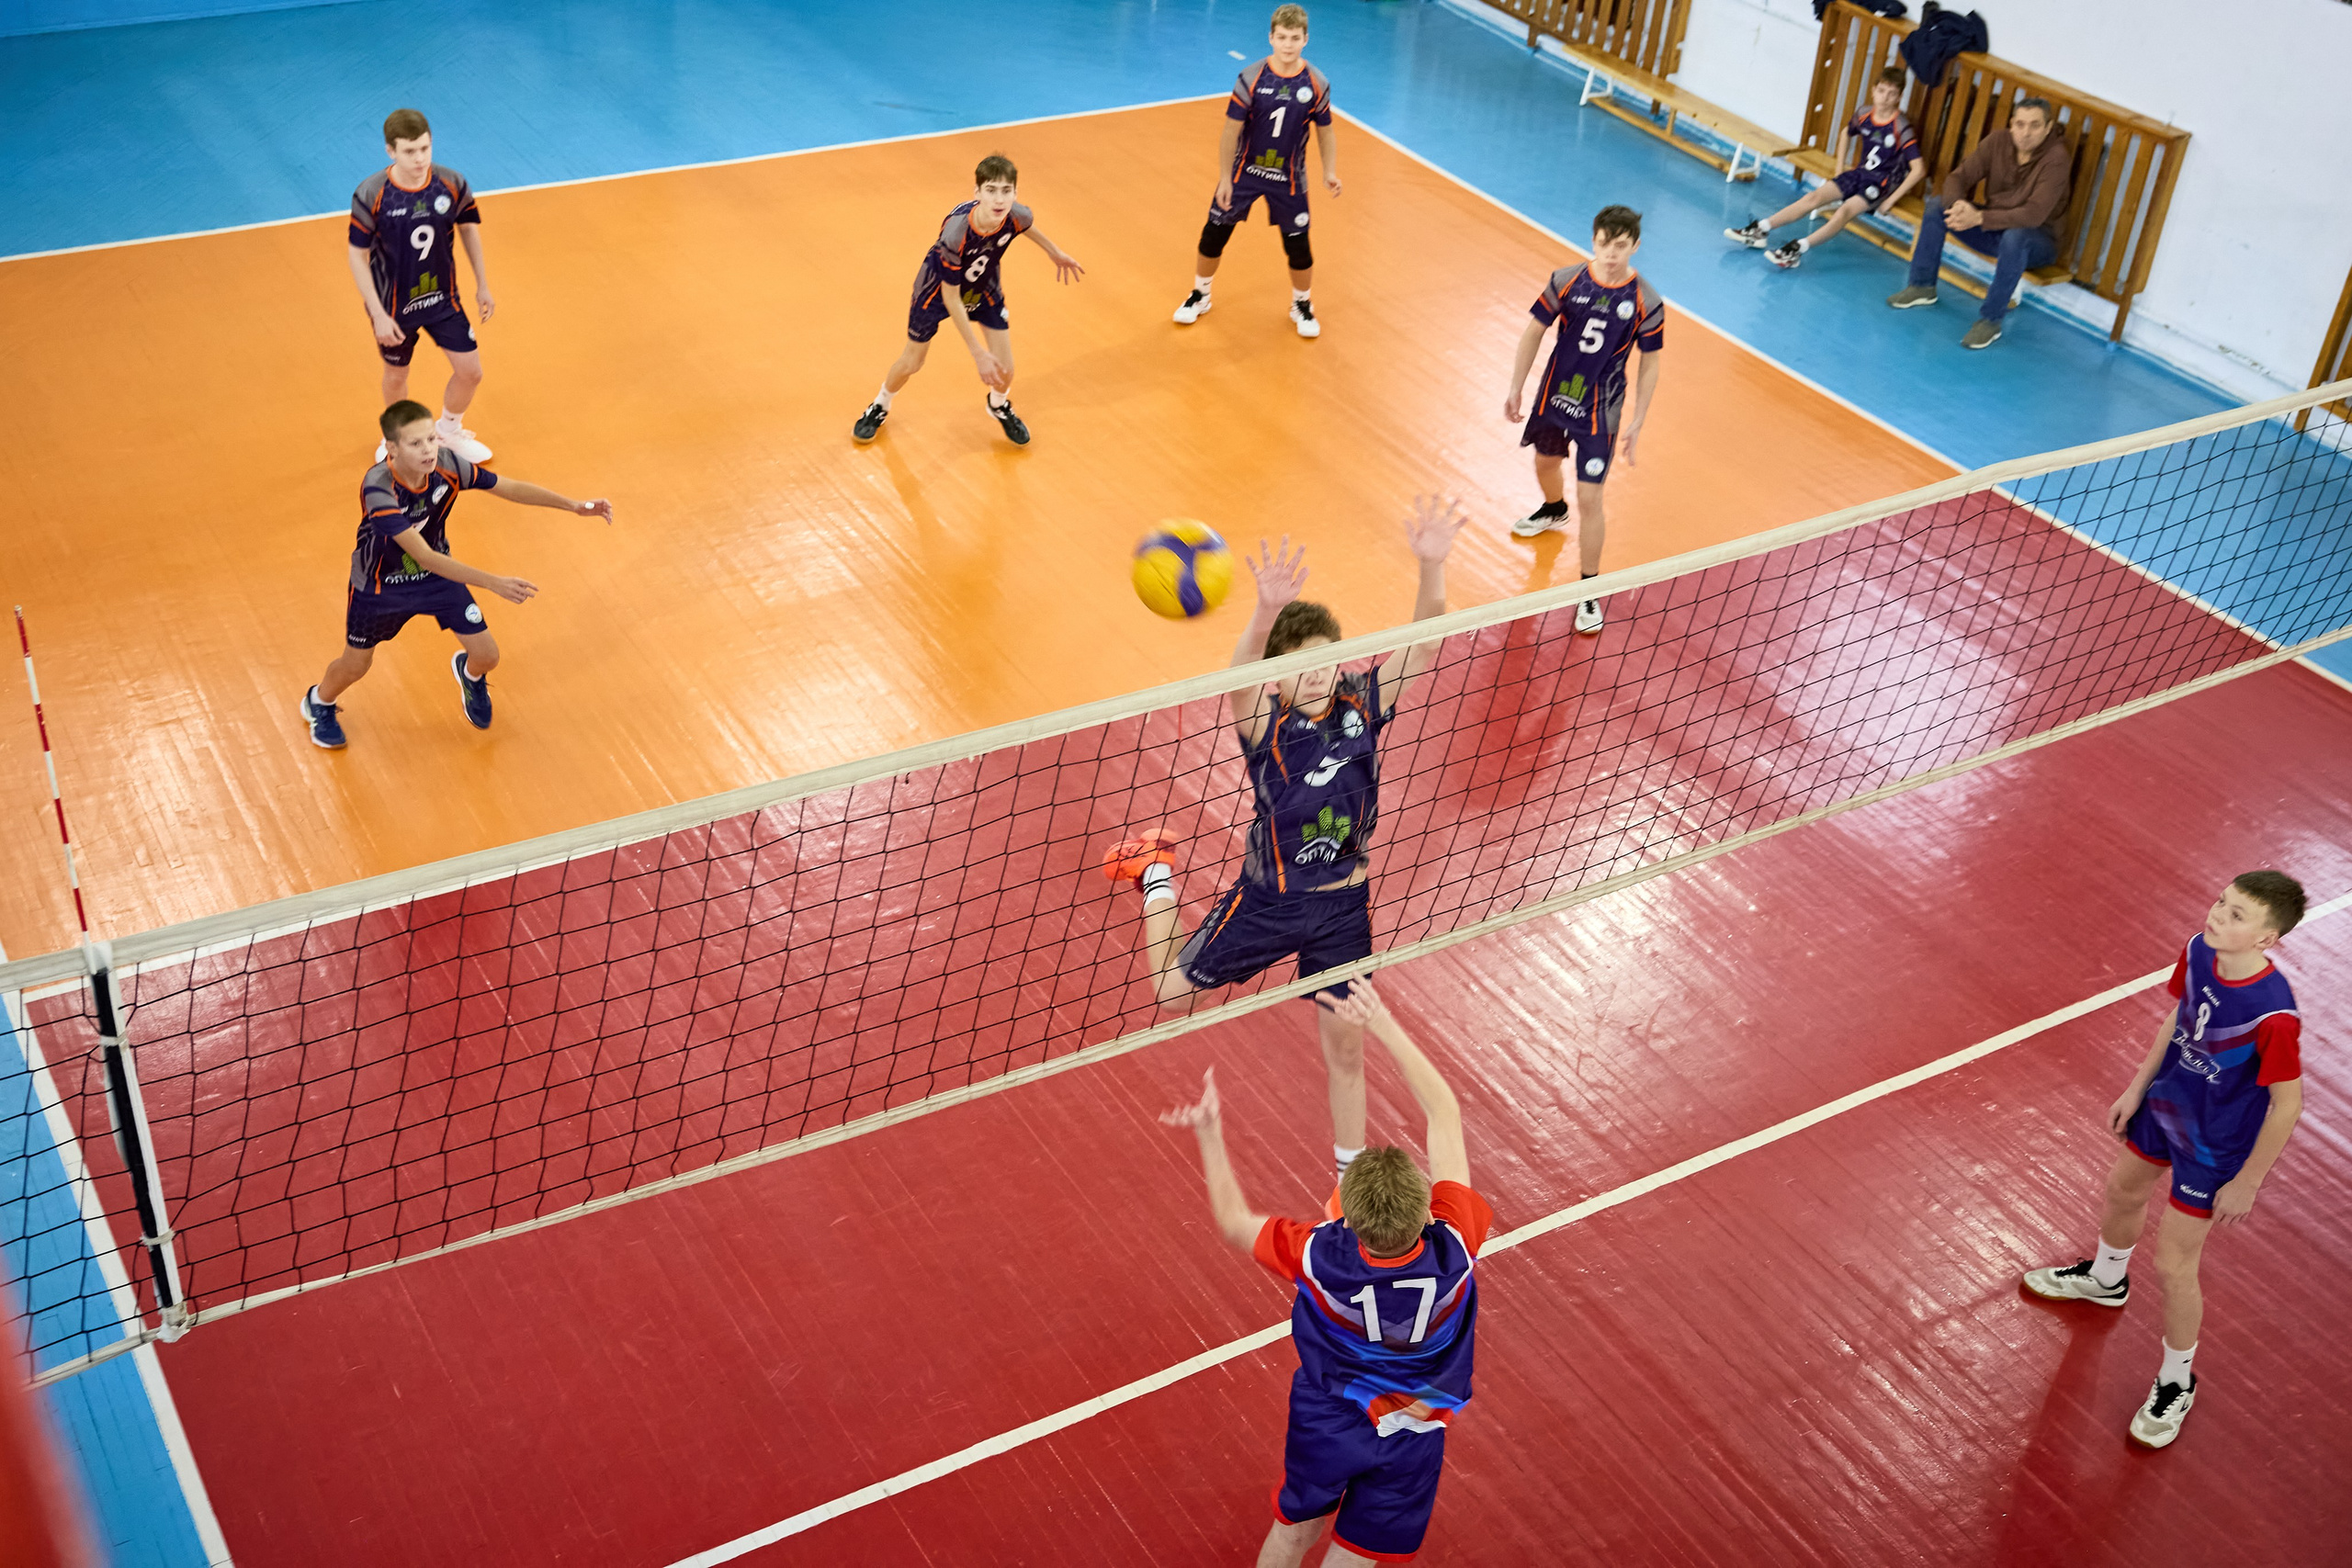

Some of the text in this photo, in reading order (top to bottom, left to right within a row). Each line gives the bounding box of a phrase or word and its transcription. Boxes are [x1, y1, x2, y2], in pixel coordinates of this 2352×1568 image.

[1269, 106, 1286, 138] 1
[1865, 145, 1882, 171] 6
[410, 224, 435, 262] 9
[965, 254, 989, 283] 8
[1577, 317, 1608, 355] 5
[2193, 1002, 2211, 1042] 8
[1350, 1277, 1437, 1343] 17
